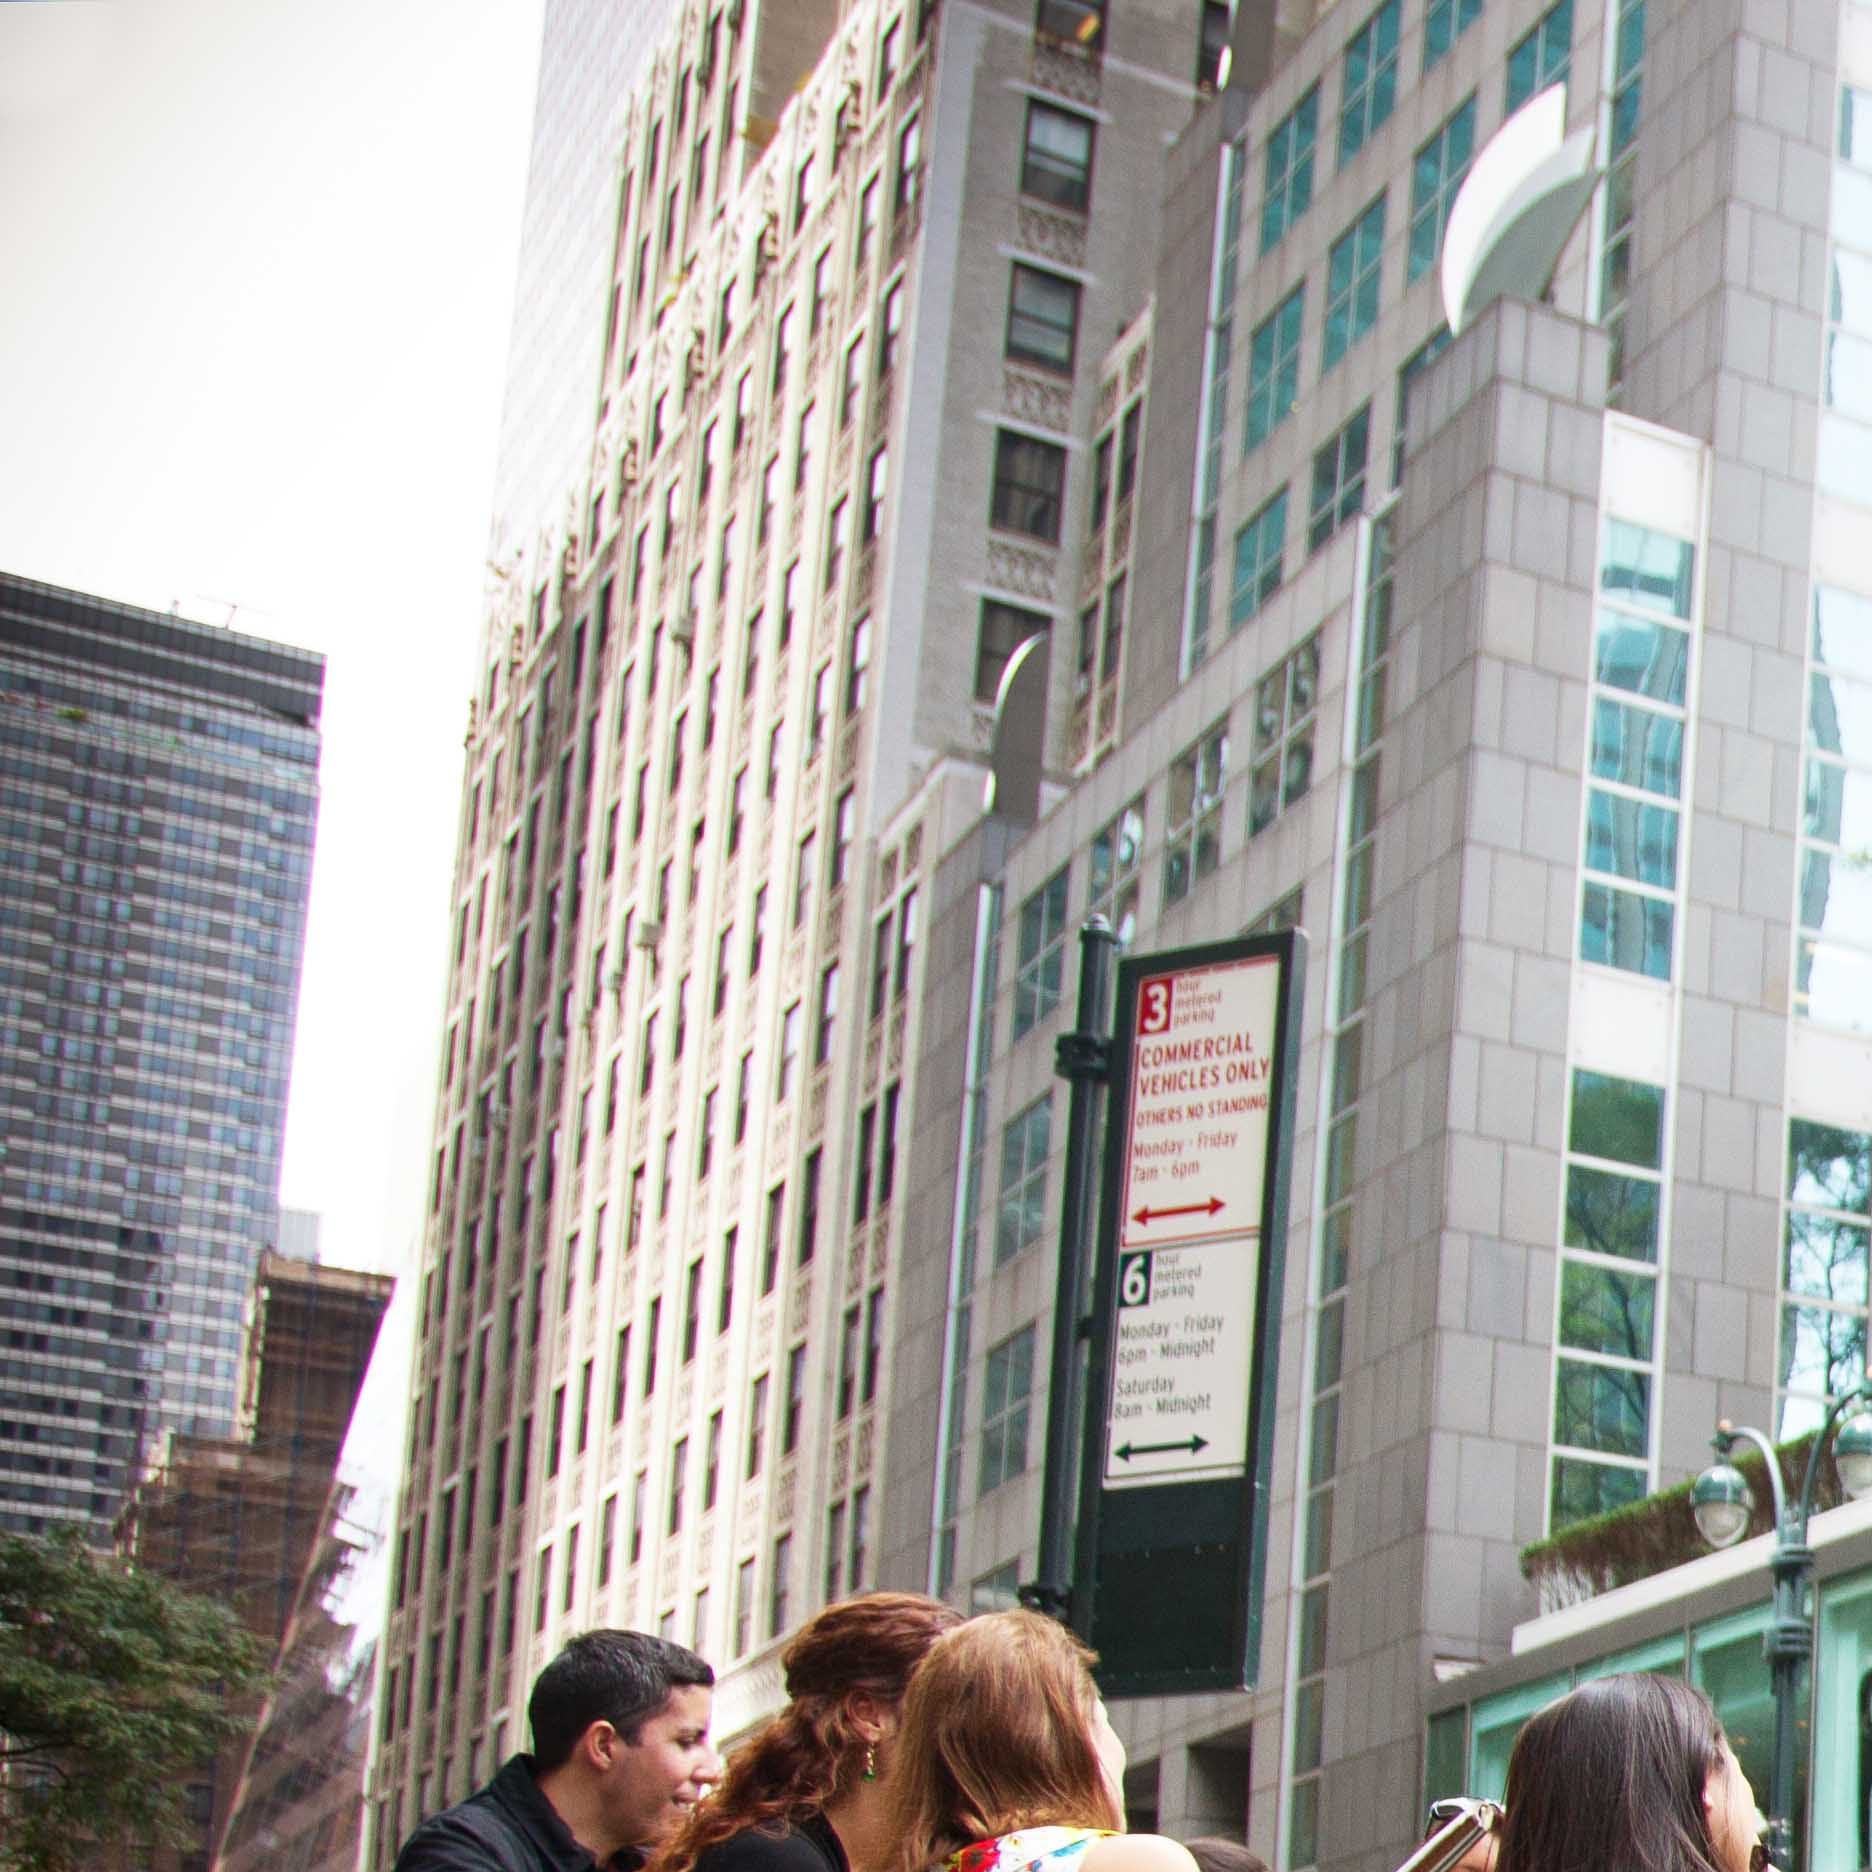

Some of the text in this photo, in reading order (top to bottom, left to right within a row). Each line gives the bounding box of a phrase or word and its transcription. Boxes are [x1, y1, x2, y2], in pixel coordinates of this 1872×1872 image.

[1144, 983, 1167, 1031] 3
[1175, 989, 1222, 1008] metered
[1174, 1009, 1215, 1028] parking
[1140, 1031, 1254, 1070] COMMERCIAL
[1140, 1056, 1270, 1097] VEHICLES ONLY
[1136, 1092, 1268, 1130] OTHERS NO STANDING
[1134, 1130, 1238, 1159] Monday Friday
[1134, 1160, 1200, 1182] 7am 6pm
[1123, 1254, 1146, 1306] 6
[1155, 1264, 1201, 1284] metered
[1153, 1283, 1195, 1303] parking
[1120, 1314, 1224, 1340] Monday Friday
[1117, 1338, 1215, 1365] 6pm Midnight
[1116, 1376, 1175, 1396] Saturday
[1114, 1393, 1211, 1420] 8am Midnight
